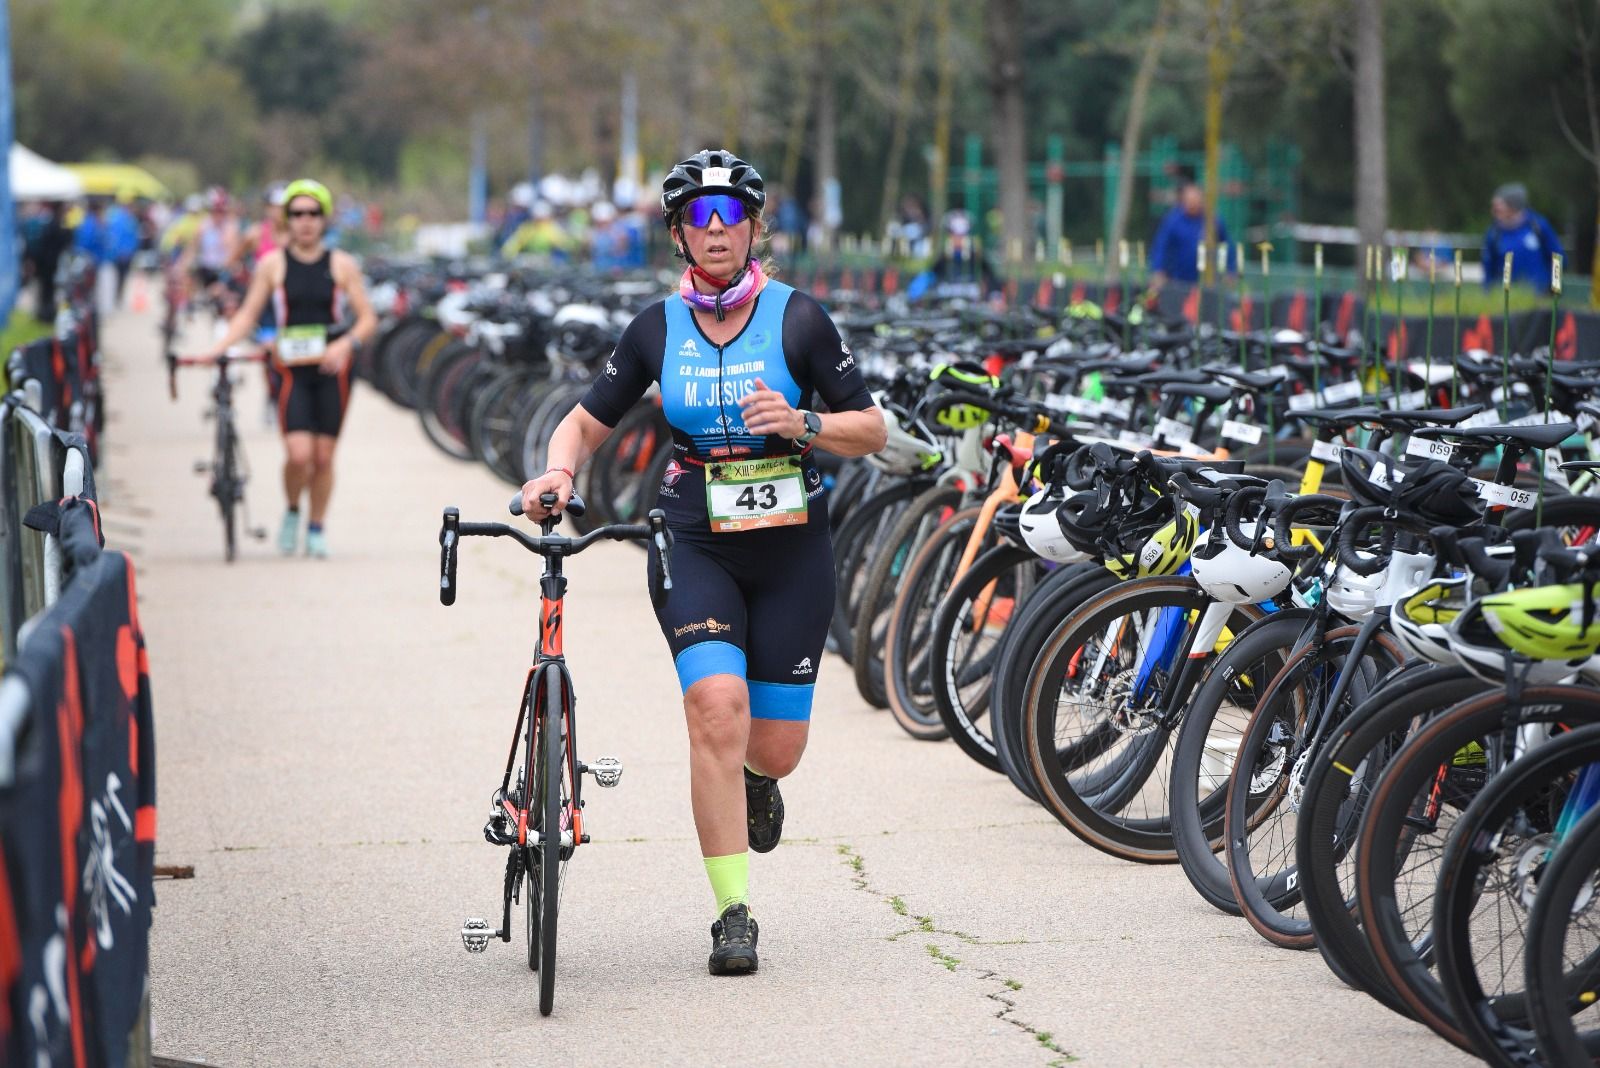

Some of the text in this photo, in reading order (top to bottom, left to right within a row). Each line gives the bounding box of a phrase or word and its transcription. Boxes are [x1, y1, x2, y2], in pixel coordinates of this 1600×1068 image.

[685, 379, 755, 407] M. JESUS
[1430, 443, 1451, 456] 059
[736, 483, 778, 510] 43
[1510, 490, 1531, 504] 055
